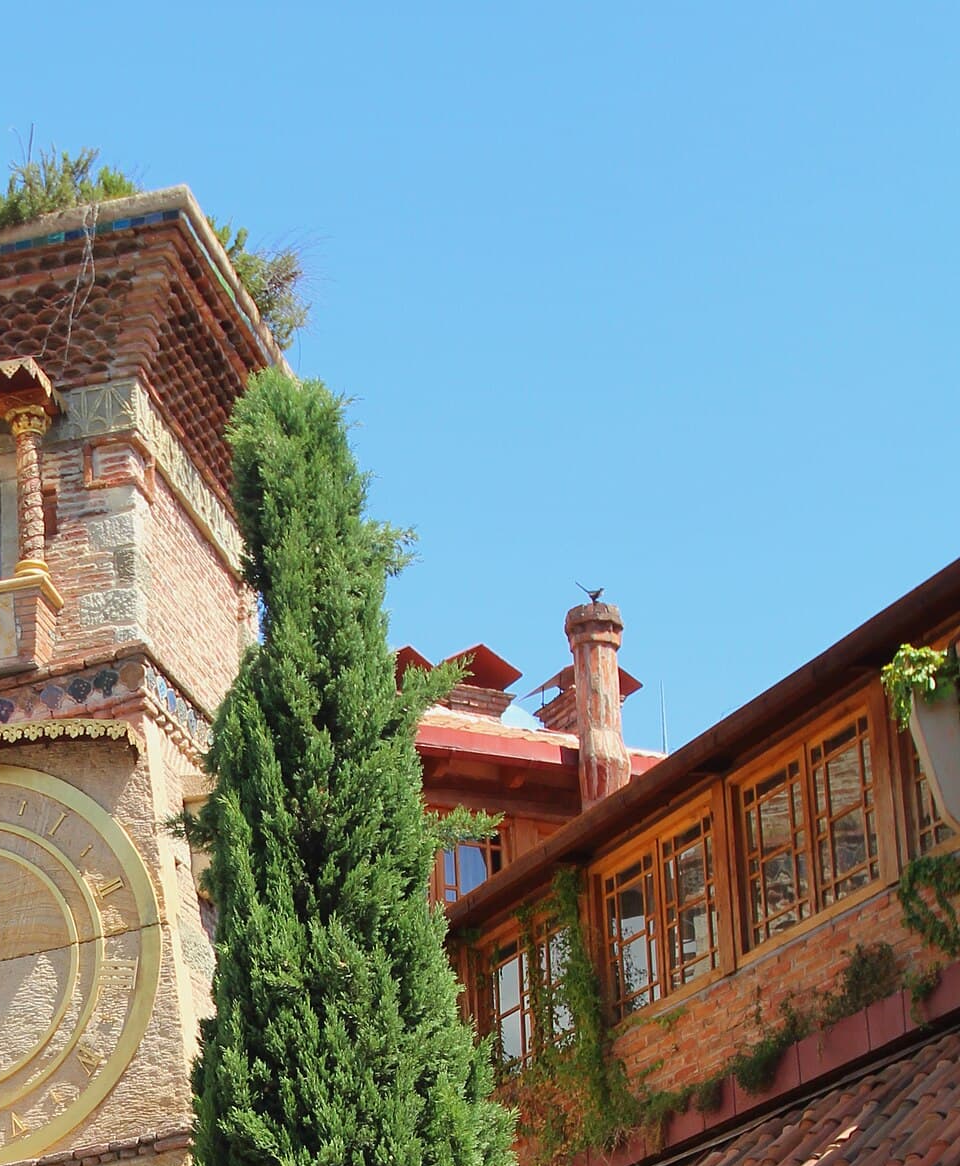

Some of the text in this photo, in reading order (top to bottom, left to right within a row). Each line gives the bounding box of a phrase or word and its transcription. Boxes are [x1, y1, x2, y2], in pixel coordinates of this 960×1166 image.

[48, 812, 67, 836] I
[95, 876, 125, 900] II
[97, 957, 139, 990] III
[76, 1045, 104, 1078] IV
[10, 1111, 31, 1138] V
